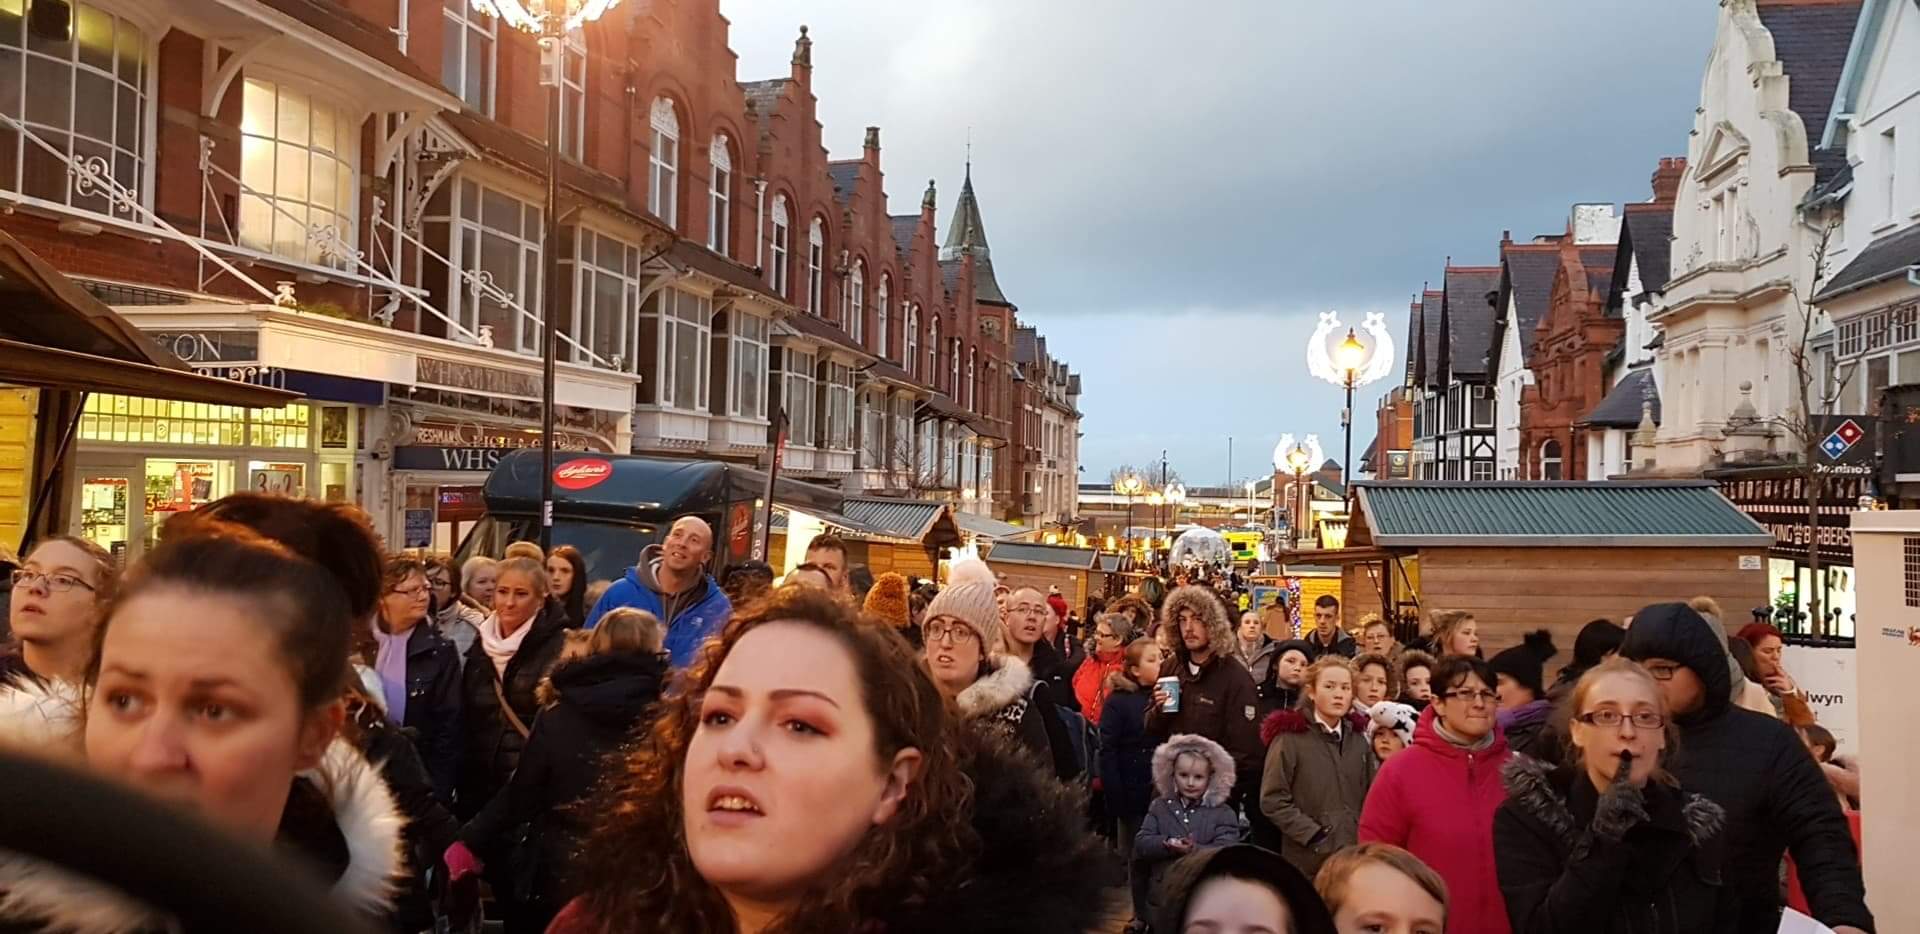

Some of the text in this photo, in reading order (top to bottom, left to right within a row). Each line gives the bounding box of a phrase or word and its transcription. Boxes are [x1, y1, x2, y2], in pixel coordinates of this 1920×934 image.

[440, 448, 500, 470] WHS
[1811, 462, 1872, 475] Domino's
[1771, 522, 1793, 542] KING
[1803, 525, 1851, 546] BRBERS
